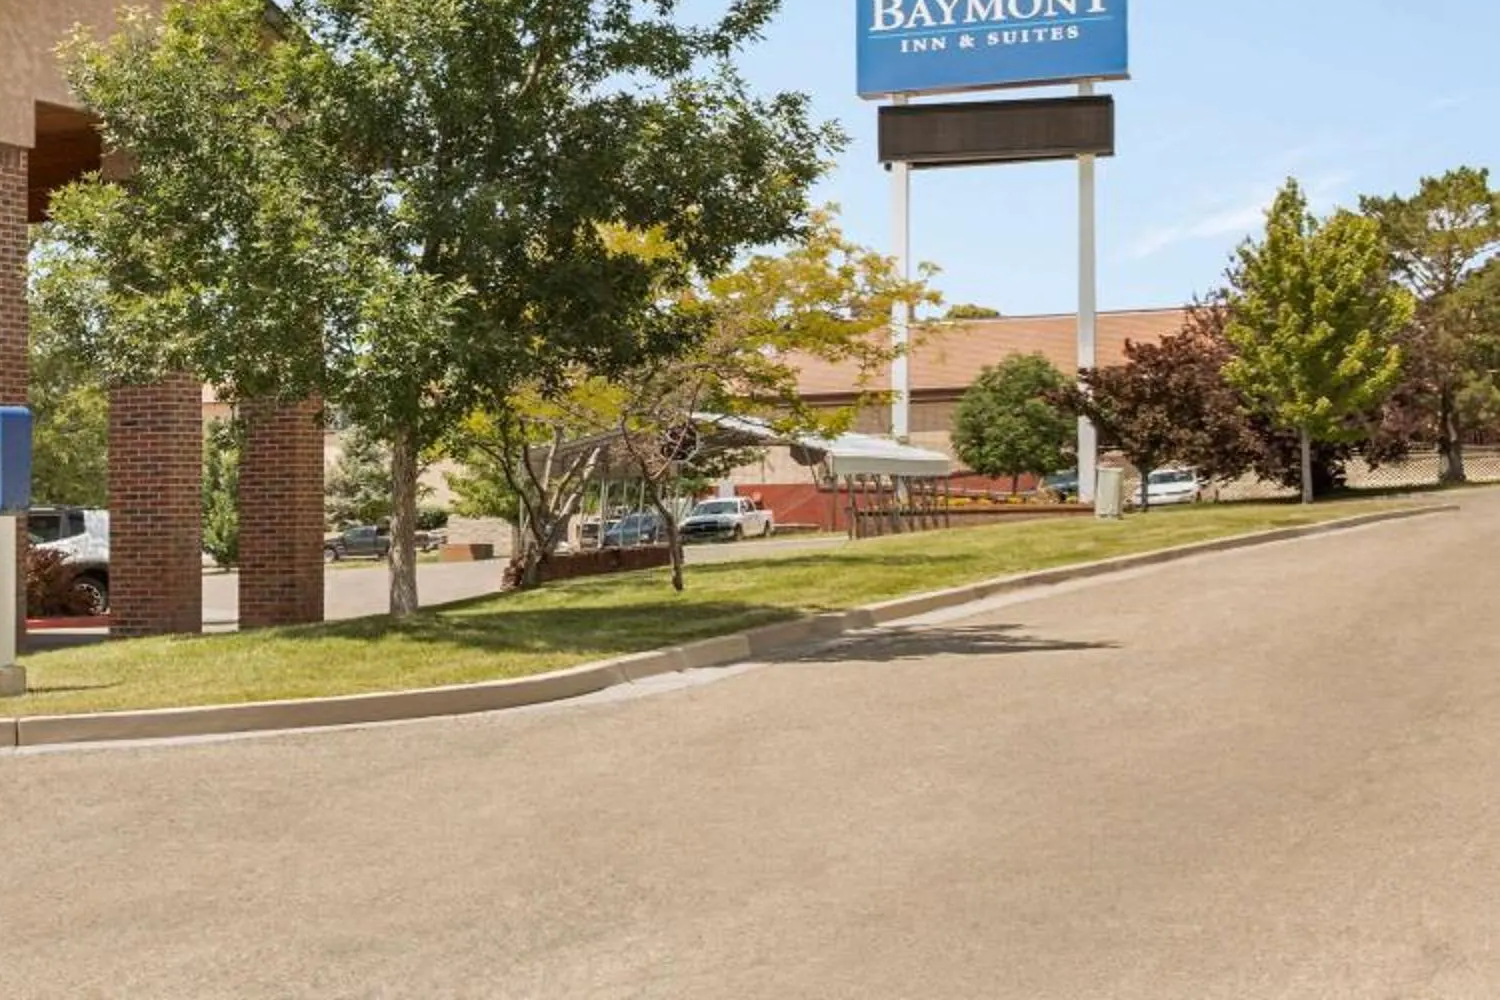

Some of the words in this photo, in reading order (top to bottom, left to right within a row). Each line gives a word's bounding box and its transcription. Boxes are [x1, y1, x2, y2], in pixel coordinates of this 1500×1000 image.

[900, 35, 947, 53] INN
[959, 34, 975, 49] &
[987, 25, 1080, 46] SUITES
